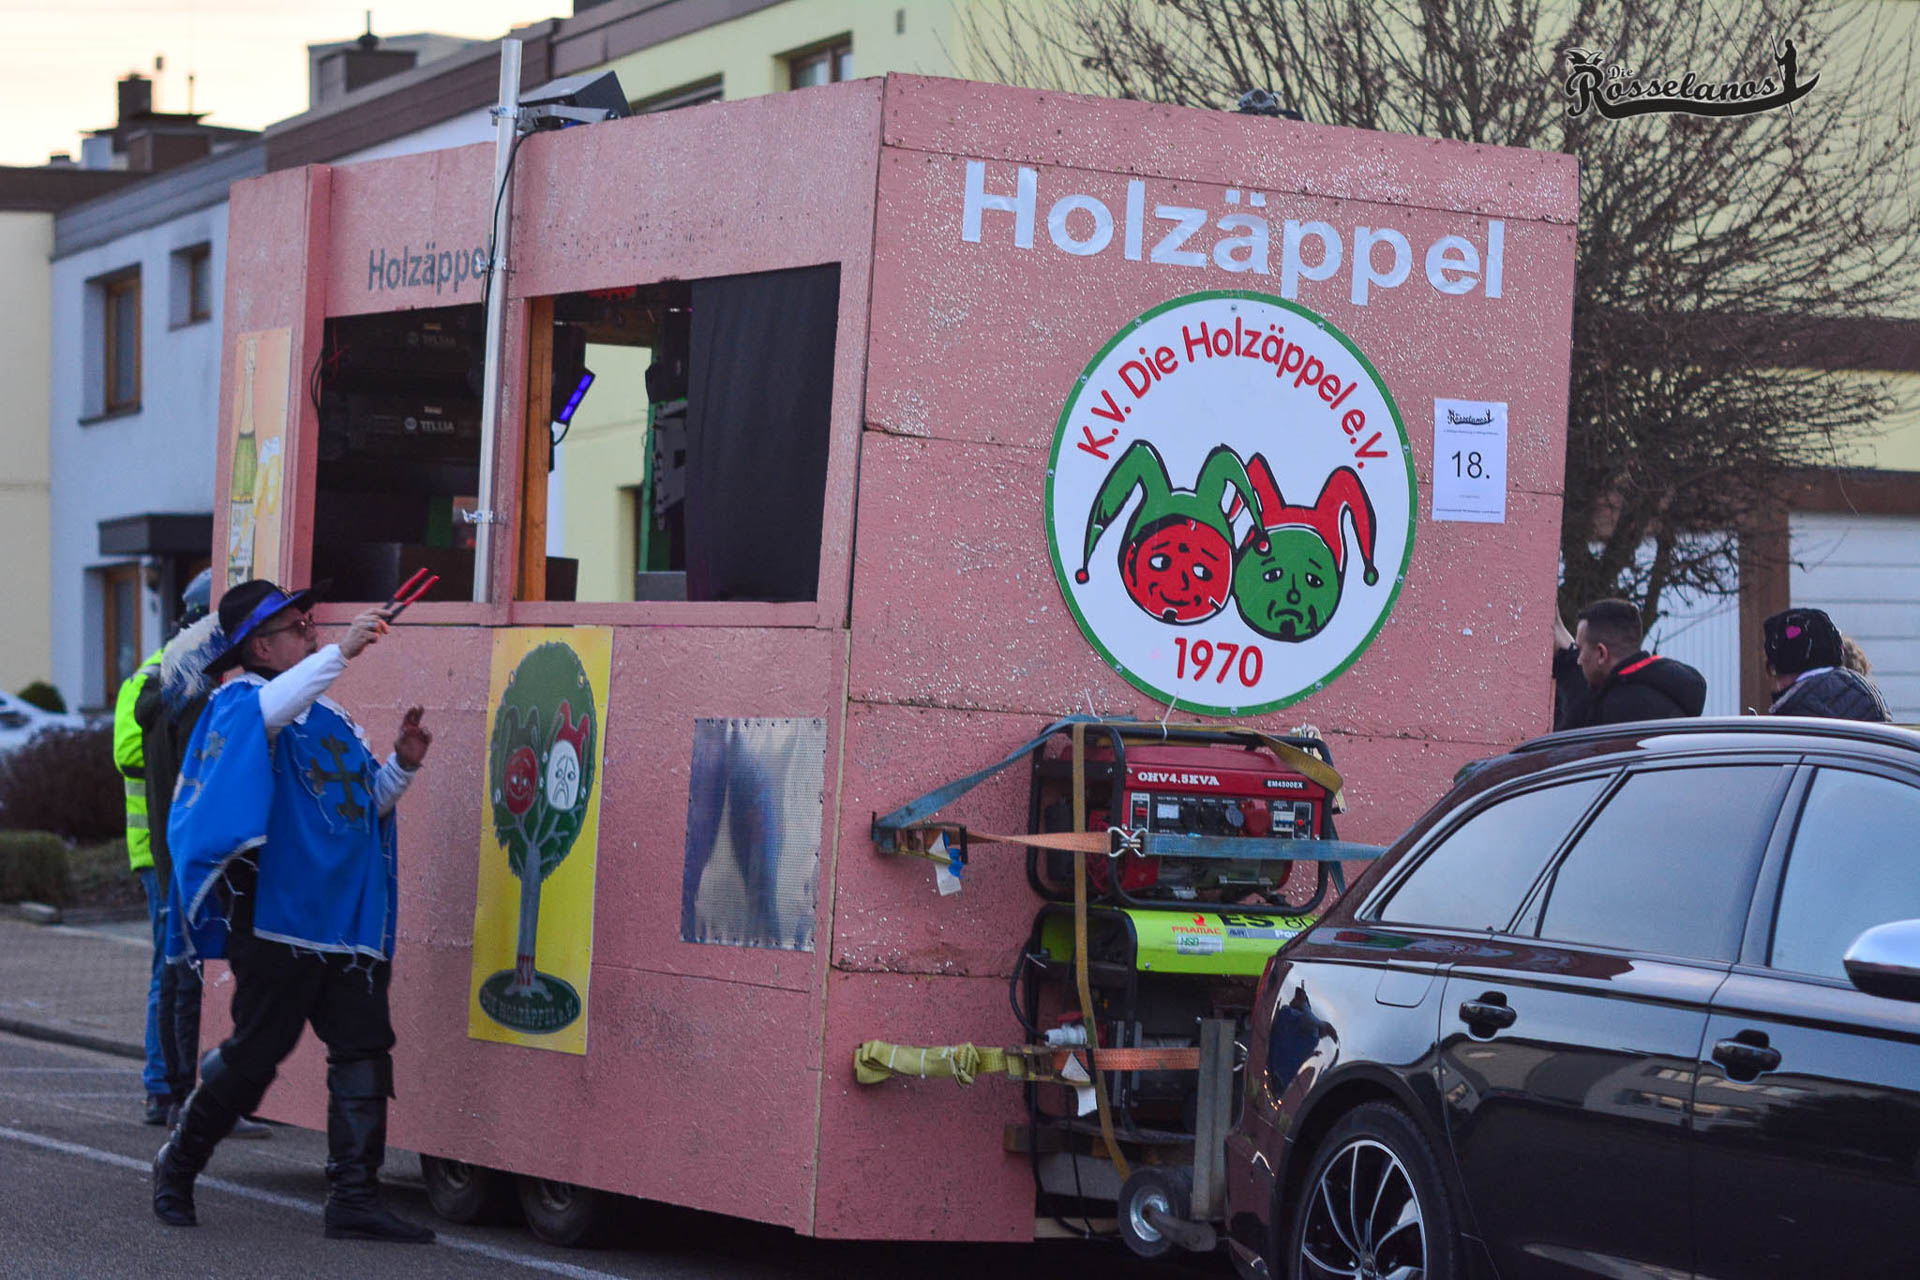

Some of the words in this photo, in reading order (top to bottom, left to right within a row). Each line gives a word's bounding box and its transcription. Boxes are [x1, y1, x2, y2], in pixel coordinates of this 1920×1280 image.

[962, 160, 1505, 306] Holzäppel
[368, 241, 491, 296] Holzäppe
[1076, 389, 1132, 461] K.V.
[1118, 346, 1179, 400] Die
[1182, 316, 1358, 410] Holzäppel
[1341, 408, 1389, 470] e.V.
[1451, 450, 1491, 479] 18.
[1174, 637, 1264, 688] 1970
[1137, 771, 1221, 787] OHV4.5KVA
[1171, 925, 1222, 936] PRAMAC
